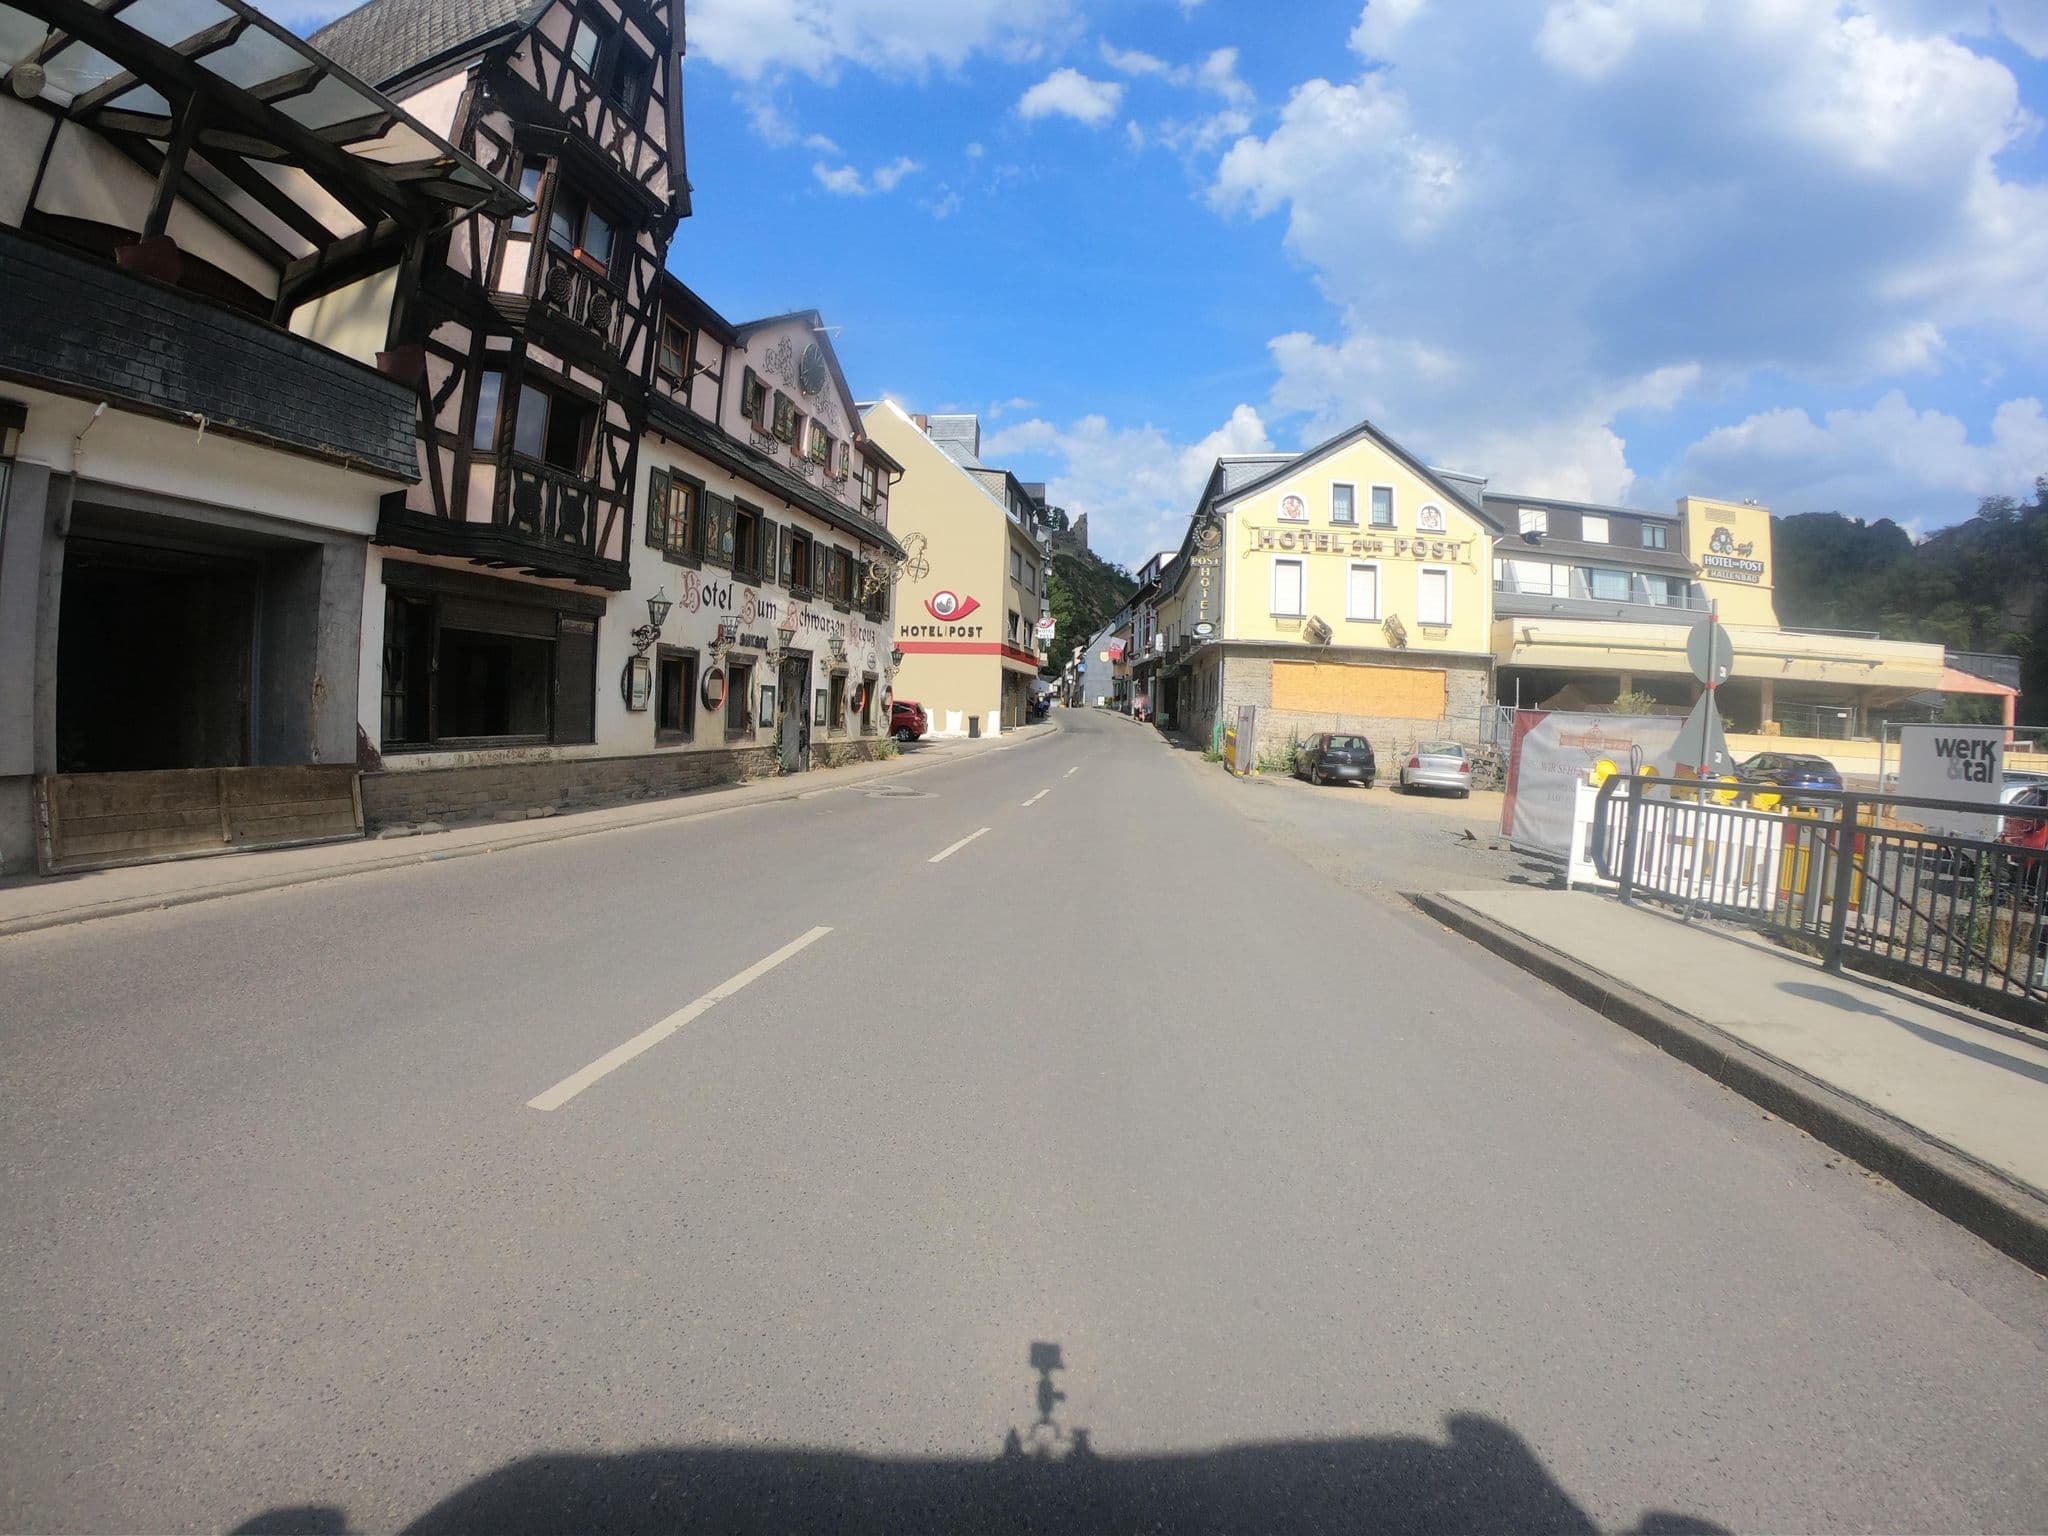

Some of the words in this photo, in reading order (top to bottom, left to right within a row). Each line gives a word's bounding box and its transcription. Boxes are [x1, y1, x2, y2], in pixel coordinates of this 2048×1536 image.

[1257, 528, 1345, 553] HOTEL
[1394, 537, 1461, 560] POST
[1704, 555, 1733, 567] HOTEL
[1740, 560, 1762, 571] POST
[1710, 570, 1759, 582] HALLENBAD
[680, 569, 734, 614] Hotel
[1200, 567, 1211, 621] HOTEL
[900, 625, 945, 638] HOTEL
[949, 626, 983, 638] POST
[1963, 759, 1995, 783] tal
